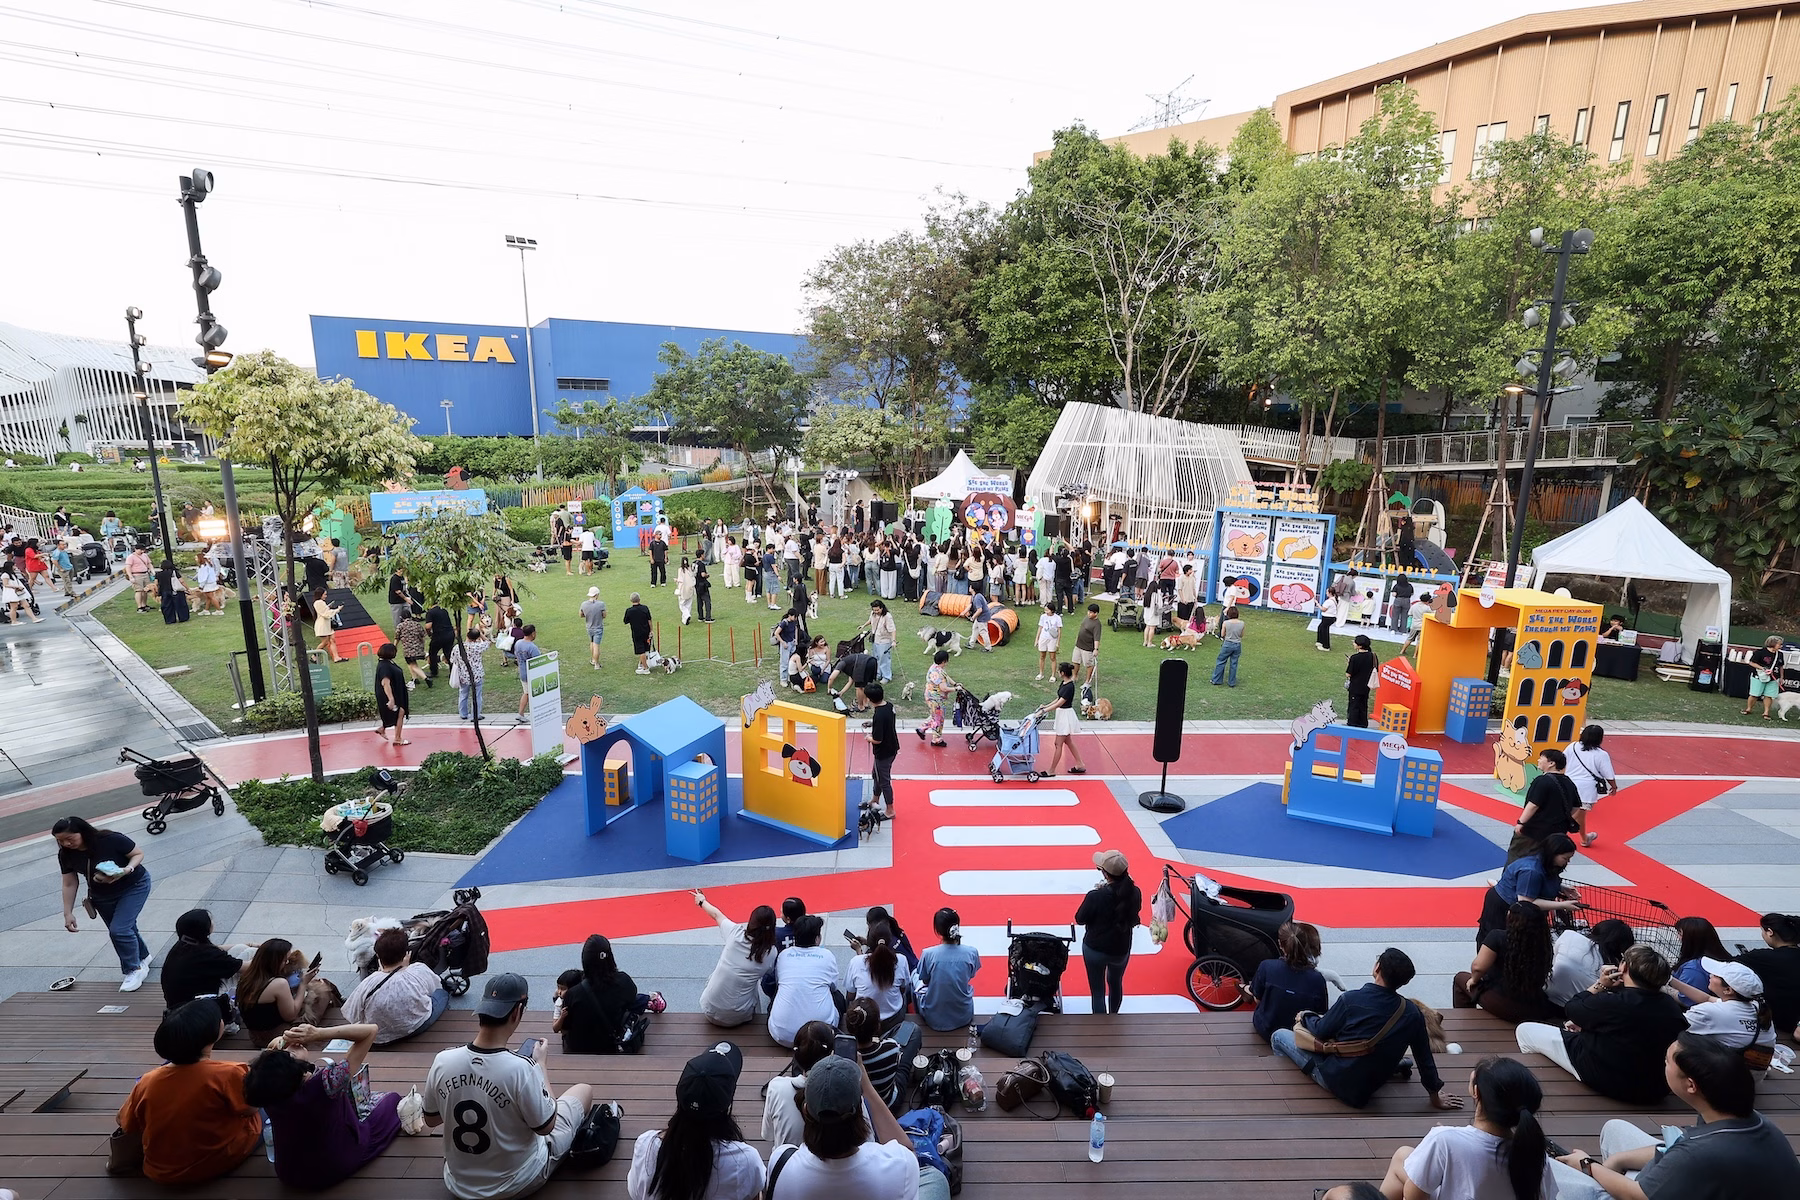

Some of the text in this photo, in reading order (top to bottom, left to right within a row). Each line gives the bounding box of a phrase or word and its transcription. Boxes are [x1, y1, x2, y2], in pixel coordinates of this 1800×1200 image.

[355, 329, 516, 364] IKEA
[1016, 514, 1033, 522] MEGA
[1348, 561, 1438, 579] ART CHARITY
[1480, 592, 1494, 601] MEGA
[1529, 614, 1598, 624] SEE THE WORLD
[1524, 625, 1558, 633] THROUGH
[1573, 625, 1597, 633] PAWS
[1783, 679, 1800, 689] MEG
[1382, 741, 1405, 751] MEGA
[438, 1073, 511, 1109] B.FERNANDES
[453, 1099, 491, 1155] 8
